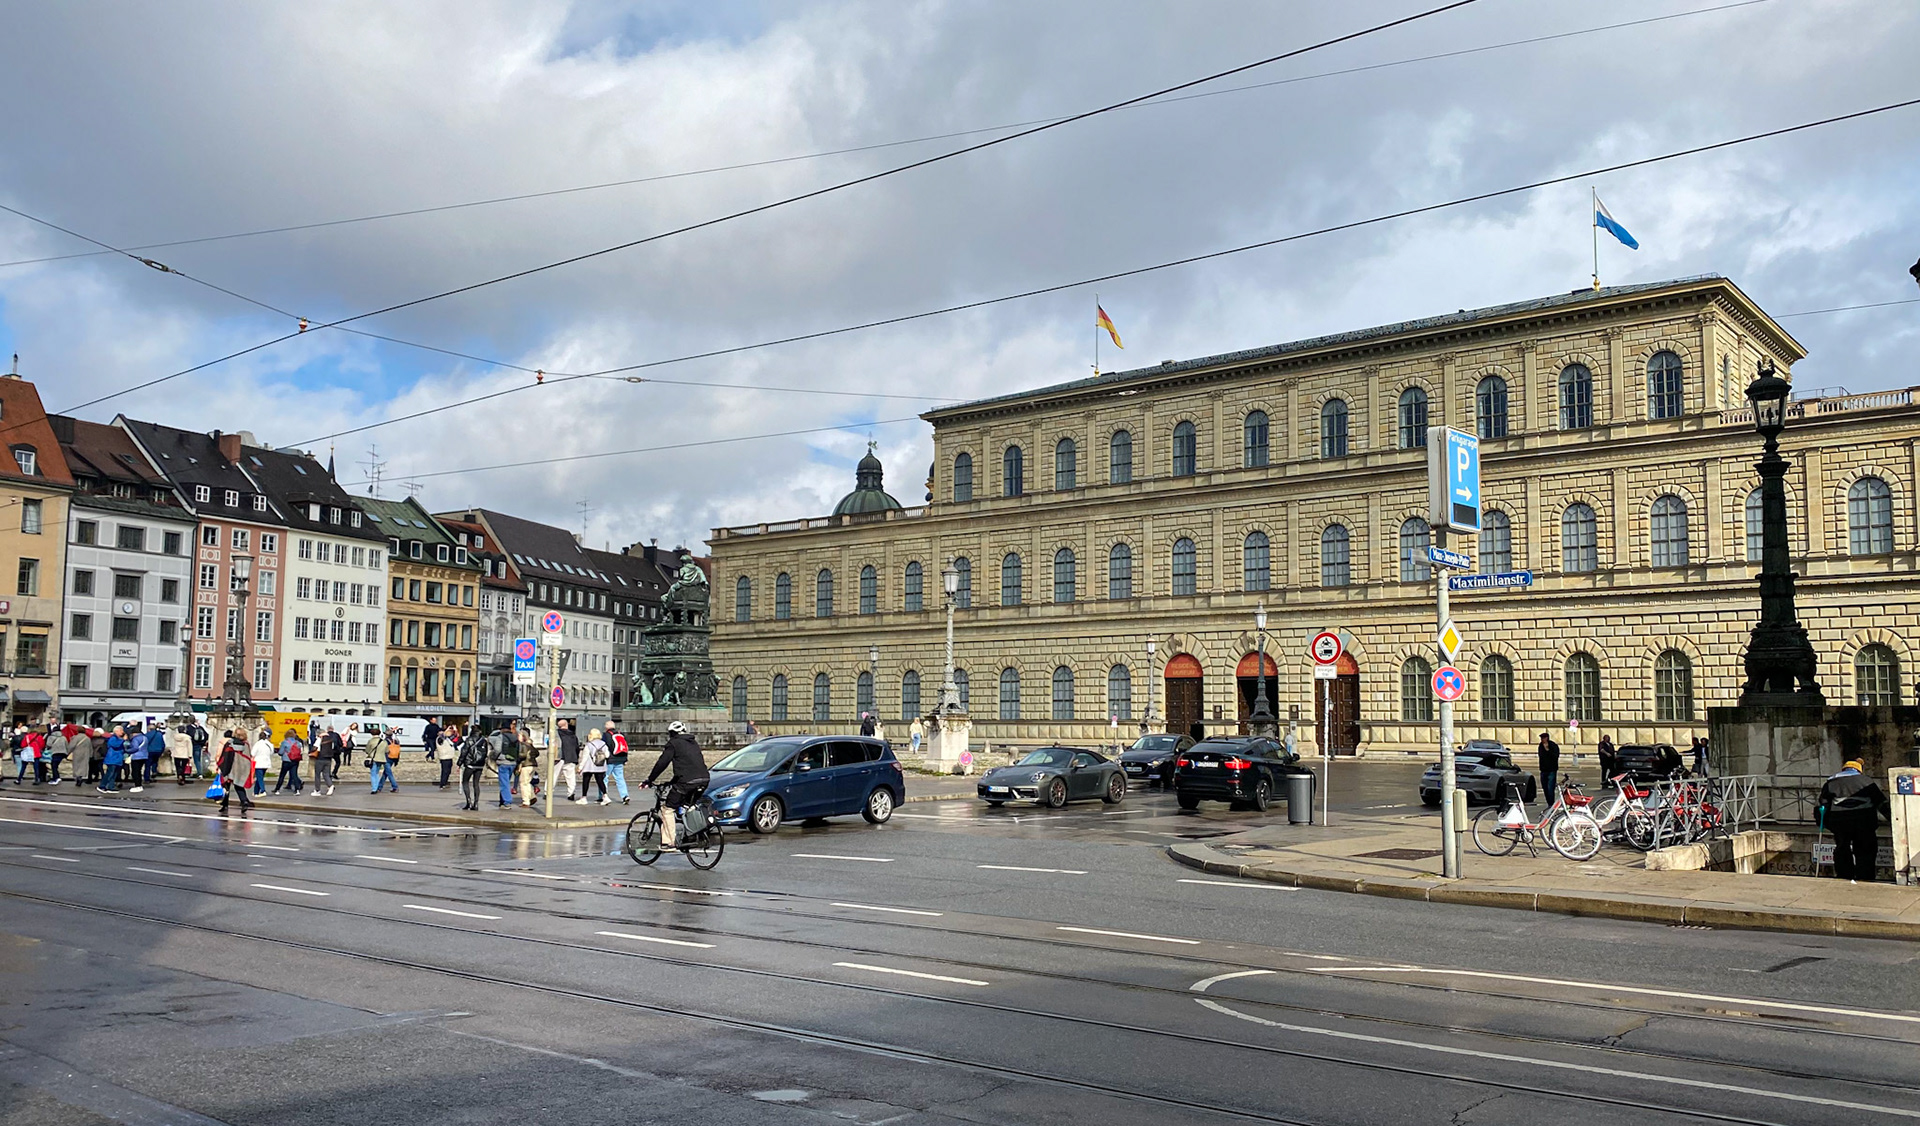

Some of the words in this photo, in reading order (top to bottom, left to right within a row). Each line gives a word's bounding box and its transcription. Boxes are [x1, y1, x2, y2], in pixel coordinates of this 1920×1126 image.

[1448, 431, 1477, 450] Parkgarage
[1457, 446, 1469, 482] P
[1452, 574, 1526, 589] Maximilianstr.
[324, 648, 352, 656] BOGNER
